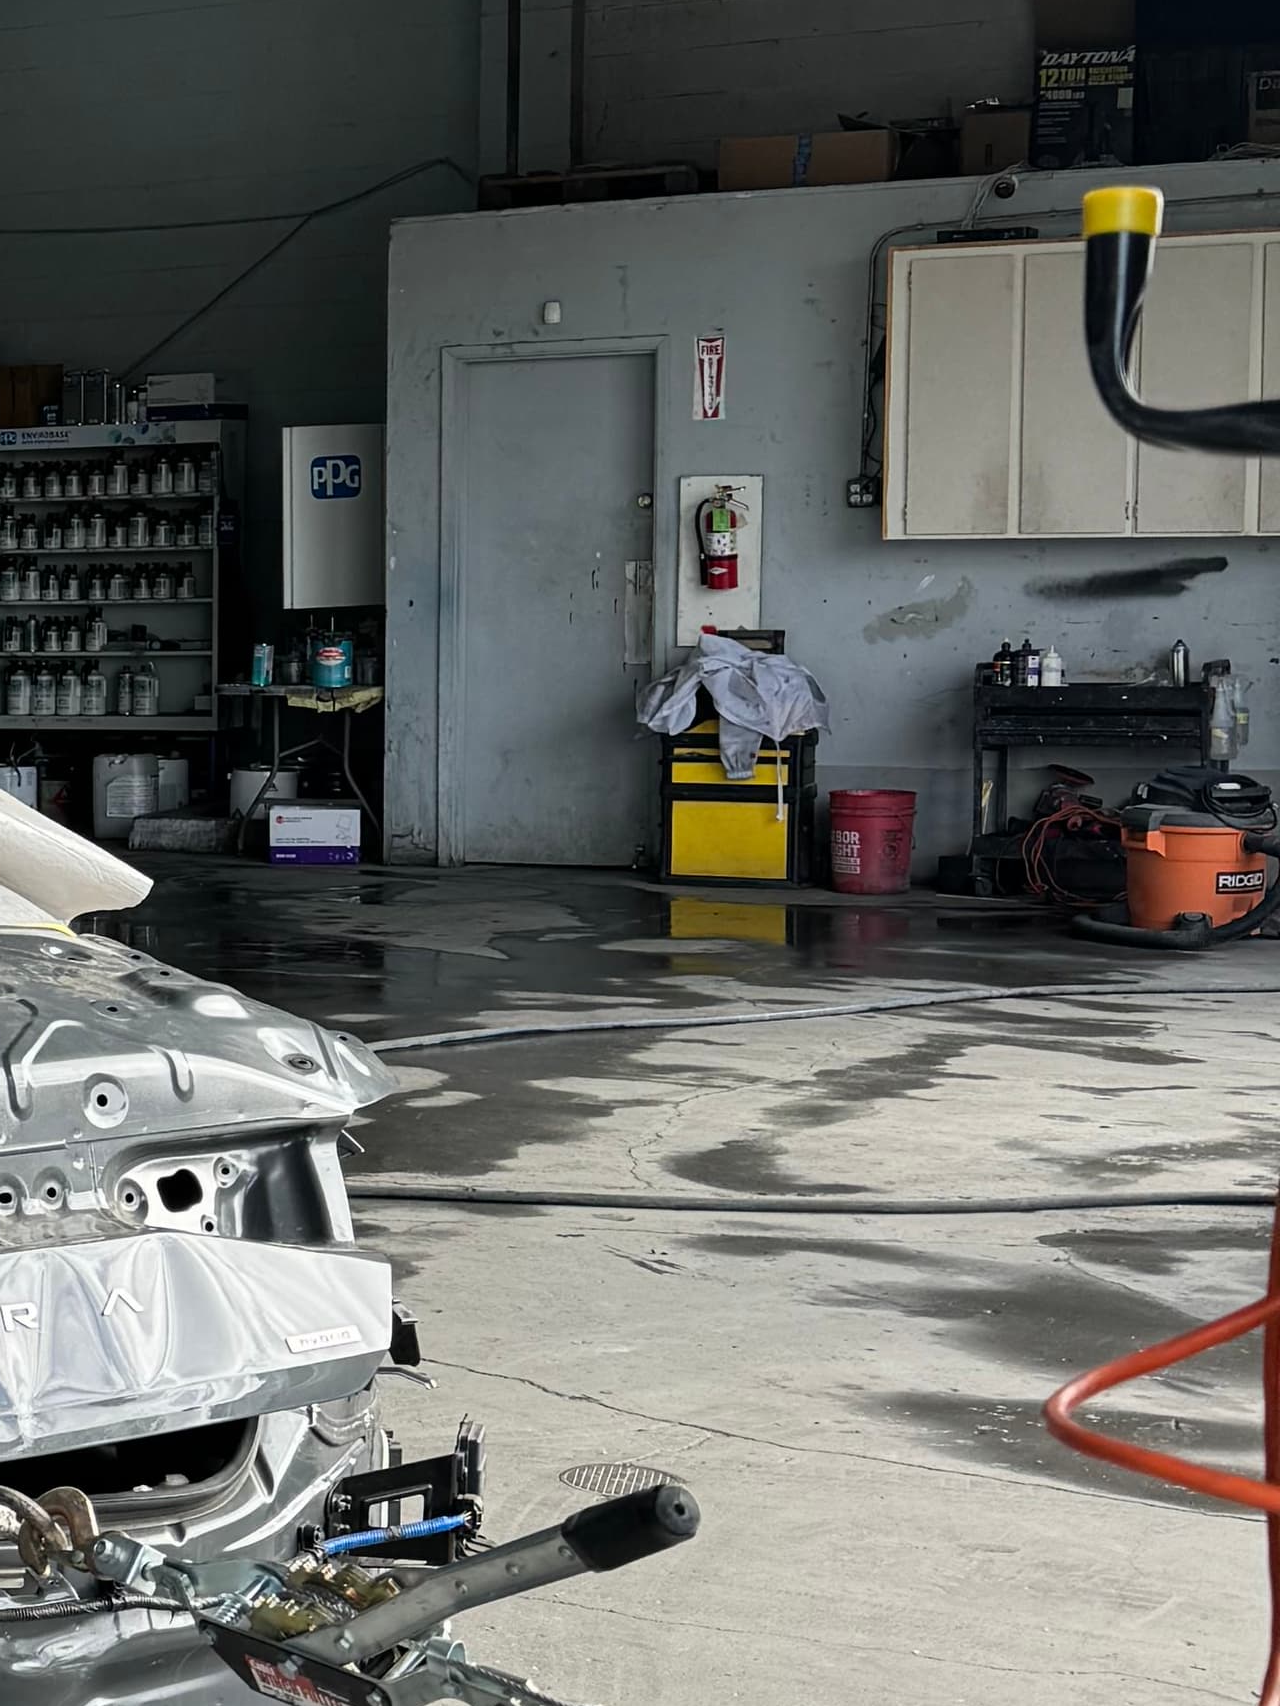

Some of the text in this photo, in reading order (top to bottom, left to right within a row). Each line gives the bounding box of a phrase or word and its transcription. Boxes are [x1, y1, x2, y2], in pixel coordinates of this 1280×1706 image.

[1040, 45, 1137, 67] DAYTONA
[1039, 68, 1059, 88] 12
[1059, 67, 1087, 82] TON
[701, 344, 721, 356] FIRE
[313, 458, 359, 497] PPG
[1218, 872, 1264, 889] RIDGID
